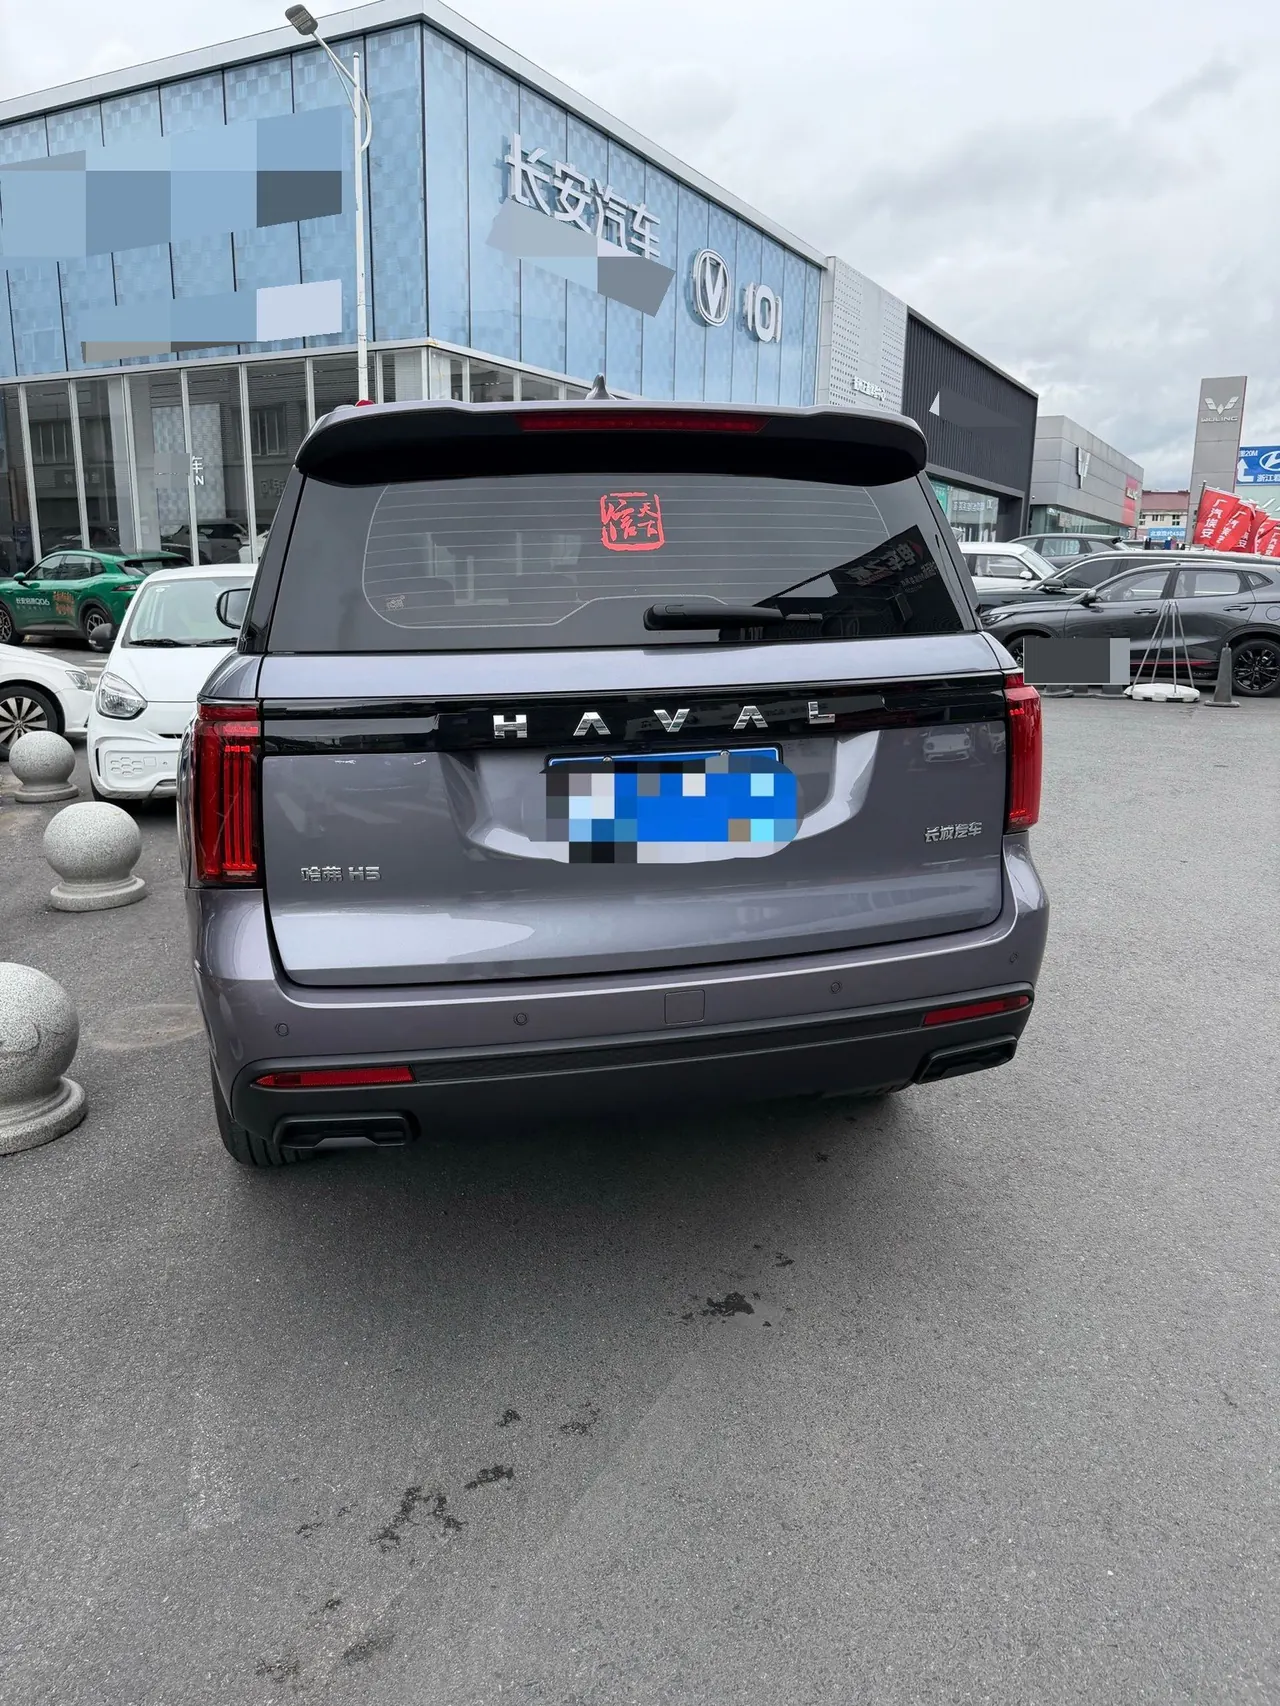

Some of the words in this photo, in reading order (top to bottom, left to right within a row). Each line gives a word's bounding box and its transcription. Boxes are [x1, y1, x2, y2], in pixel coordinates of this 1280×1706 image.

[504, 132, 660, 259] 长安汽车
[1200, 499, 1228, 538] 广汽埃安
[493, 701, 836, 739] HAVAL
[925, 822, 982, 842] 长城汽车
[301, 866, 342, 881] 哈弗
[348, 866, 381, 881] H5
